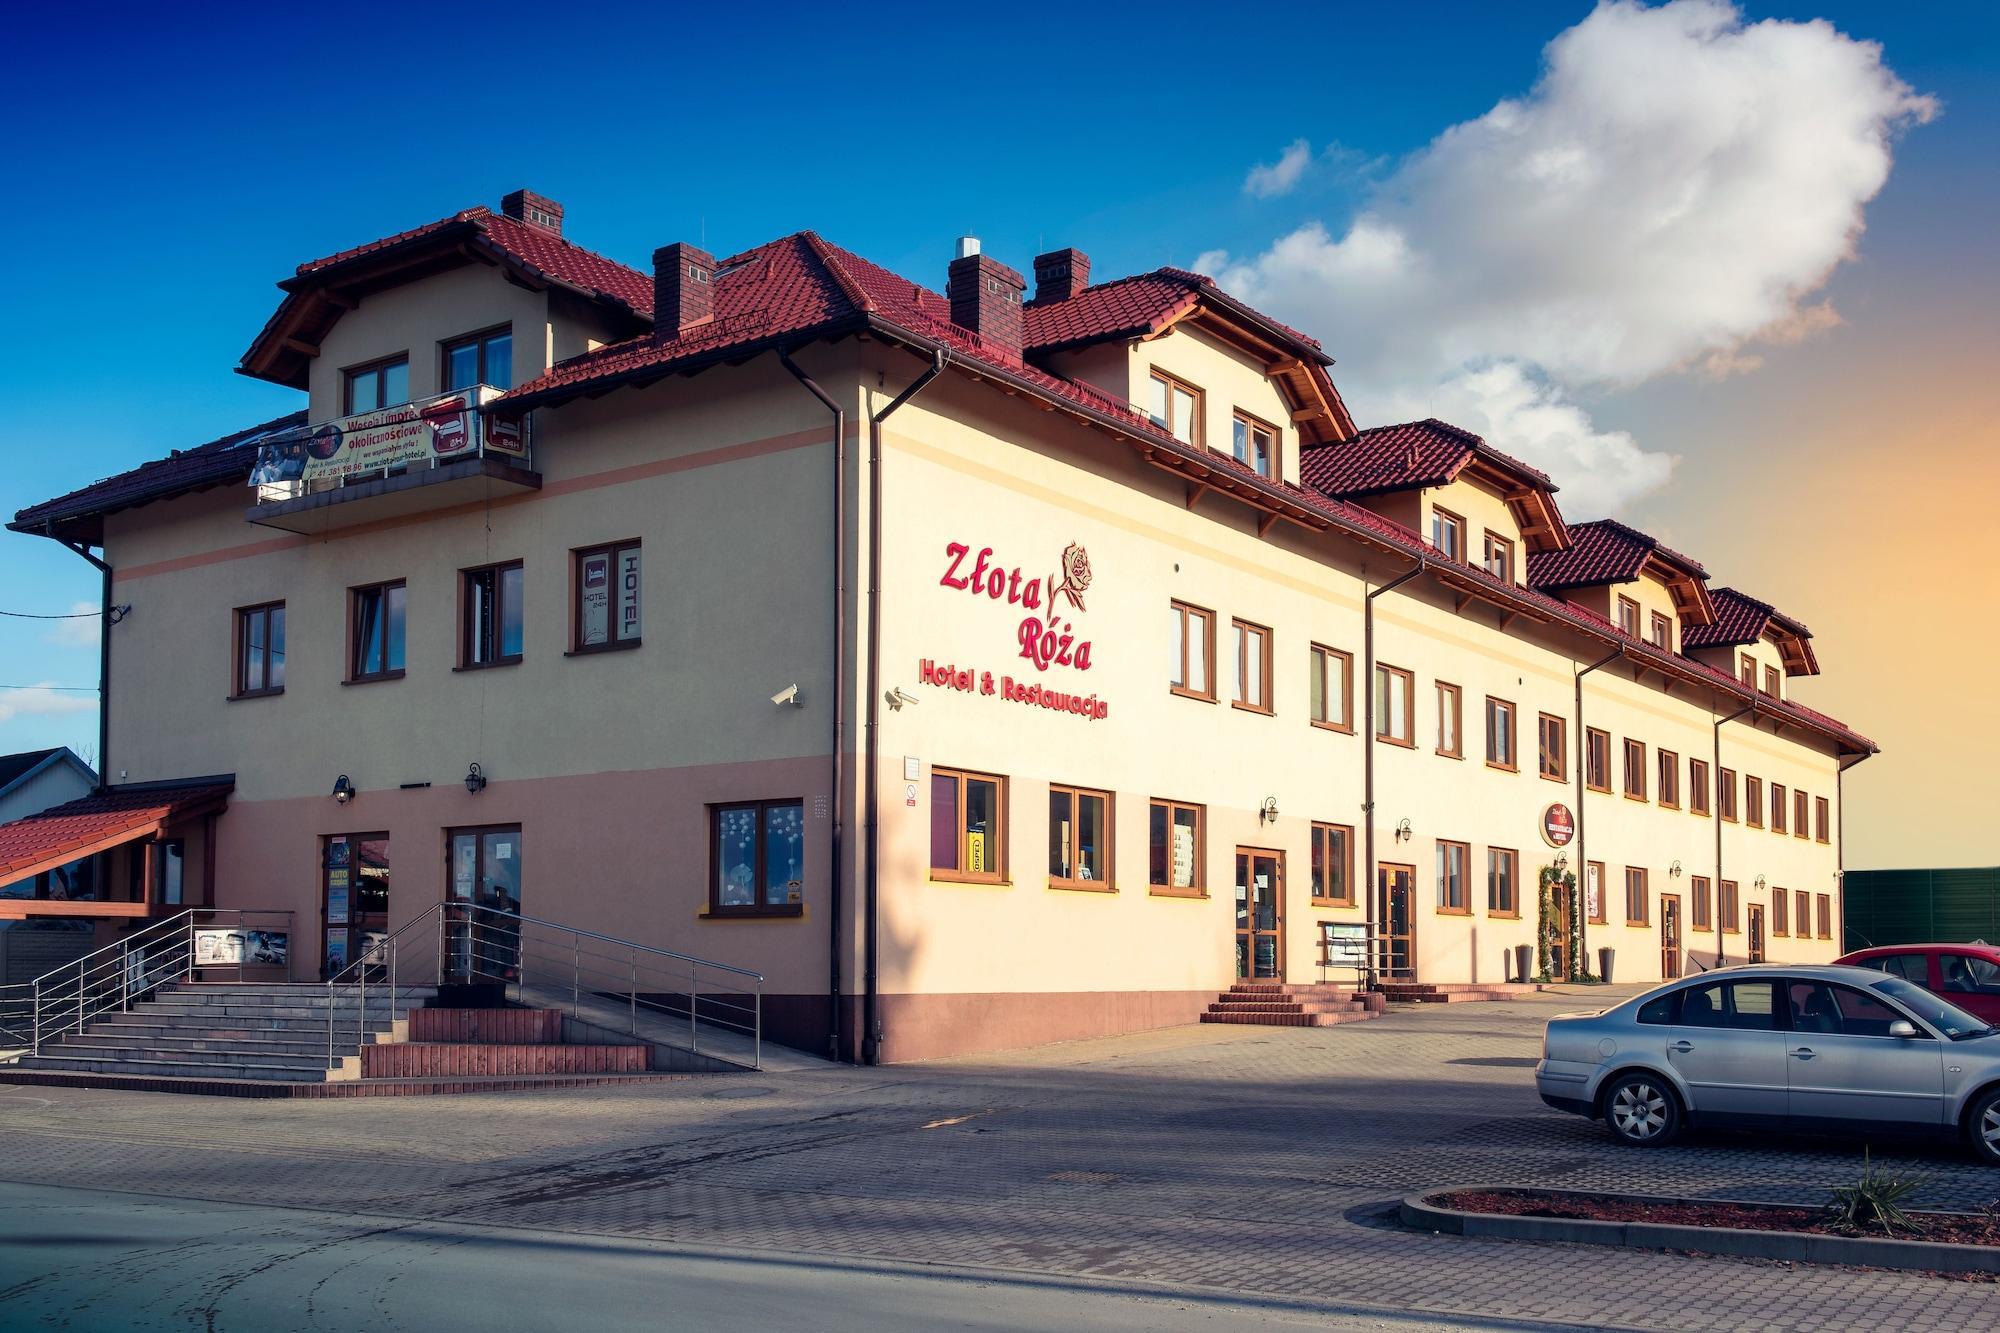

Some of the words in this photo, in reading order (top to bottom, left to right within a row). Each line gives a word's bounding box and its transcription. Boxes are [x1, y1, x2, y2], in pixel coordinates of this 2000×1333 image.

[347, 415, 379, 431] Wesela
[348, 425, 423, 449] okolicznościowe
[502, 438, 519, 448] 24H
[940, 542, 1041, 609] Złota
[584, 593, 607, 602] HOTEL
[625, 557, 637, 633] HOTEL
[1018, 616, 1092, 671] Róża
[919, 658, 975, 693] Hotel
[980, 671, 995, 695] &
[1001, 676, 1108, 721] Restauracja
[330, 870, 348, 879] AUTO
